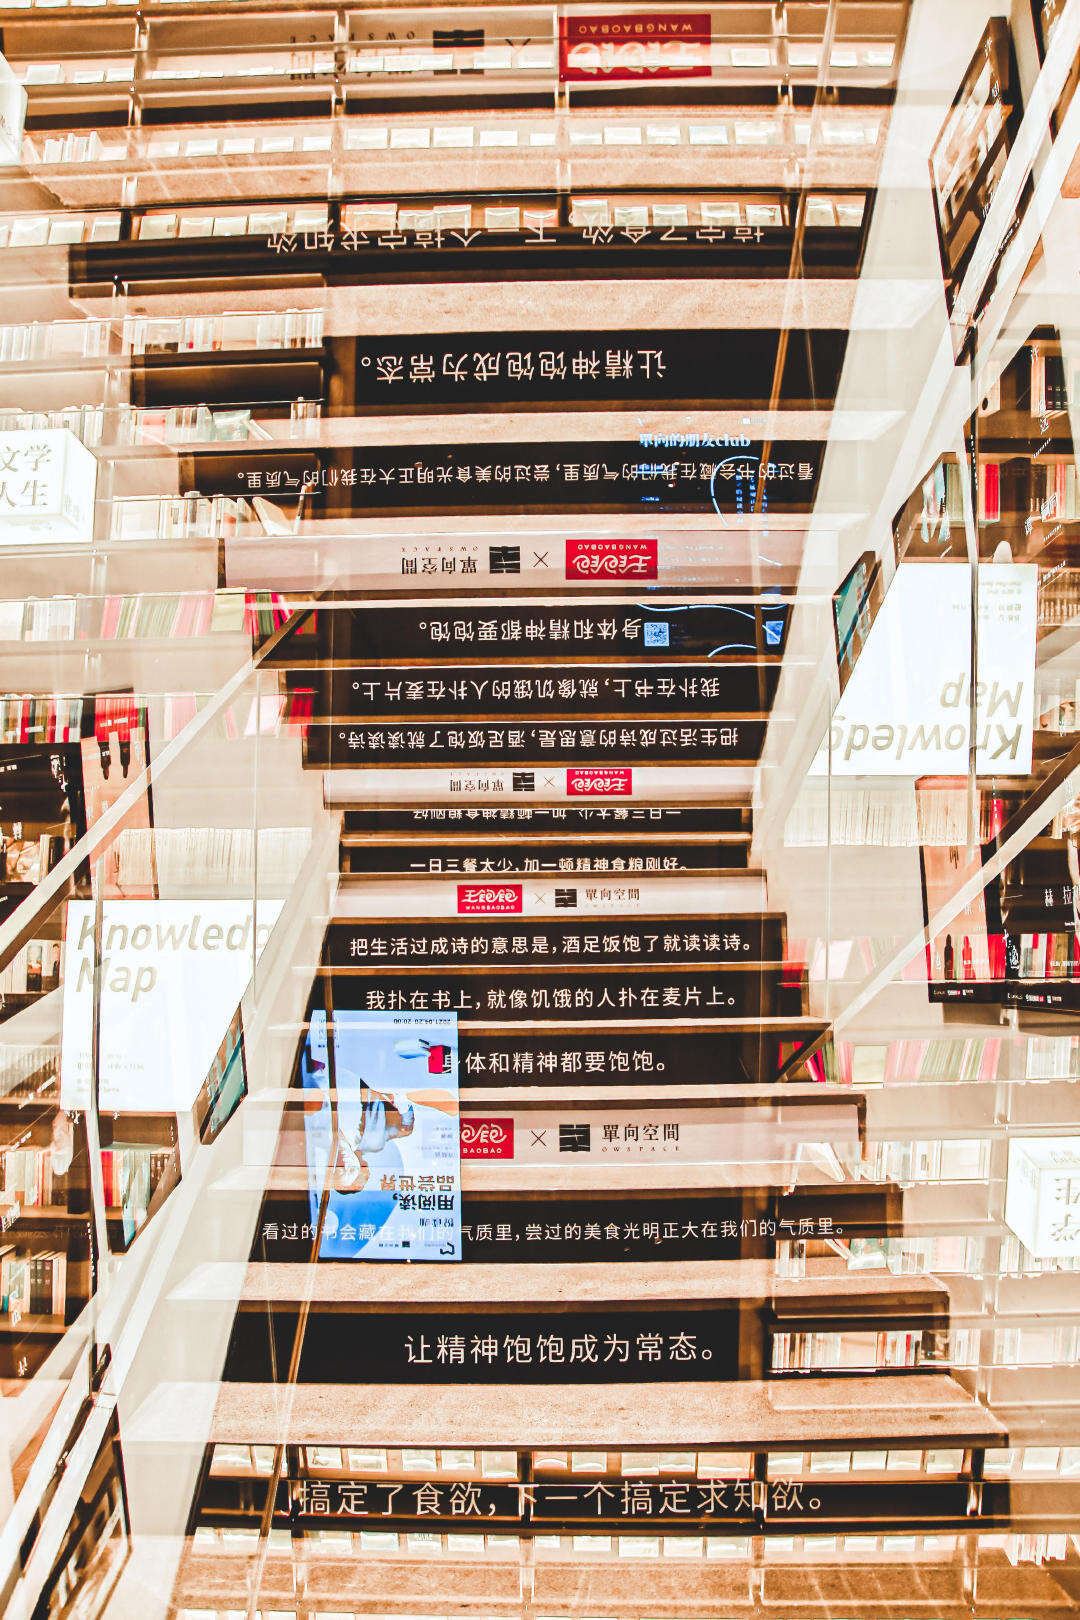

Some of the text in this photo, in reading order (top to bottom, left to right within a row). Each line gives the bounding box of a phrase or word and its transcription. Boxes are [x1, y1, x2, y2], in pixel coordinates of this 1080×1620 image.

[577, 23, 693, 35] WANGBAOBAO
[360, 349, 667, 385] 让精神饱饱成为常态。
[400, 555, 479, 576] 單向空間
[416, 617, 643, 643] 身体和精神都要饱饱。
[350, 676, 721, 701] 我扑在书上，就像饥饿的人扑在麦片上。
[336, 726, 739, 750] 把生活过成诗的意思是，酒足饭饱了就读读诗。
[349, 933, 752, 957] 把生活过成诗的意思是，酒足饭饱了就读读诗。
[365, 986, 738, 1011] 我扑在书上，就像饥饿的人扑在麦片上。
[601, 1122, 680, 1143] 單向空間
[380, 1173, 455, 1192] 品尝世界
[404, 1331, 713, 1365] 让精神饱饱成为常态。
[299, 1478, 822, 1518] 搞定了食欲，下一个搞定求知欲。
